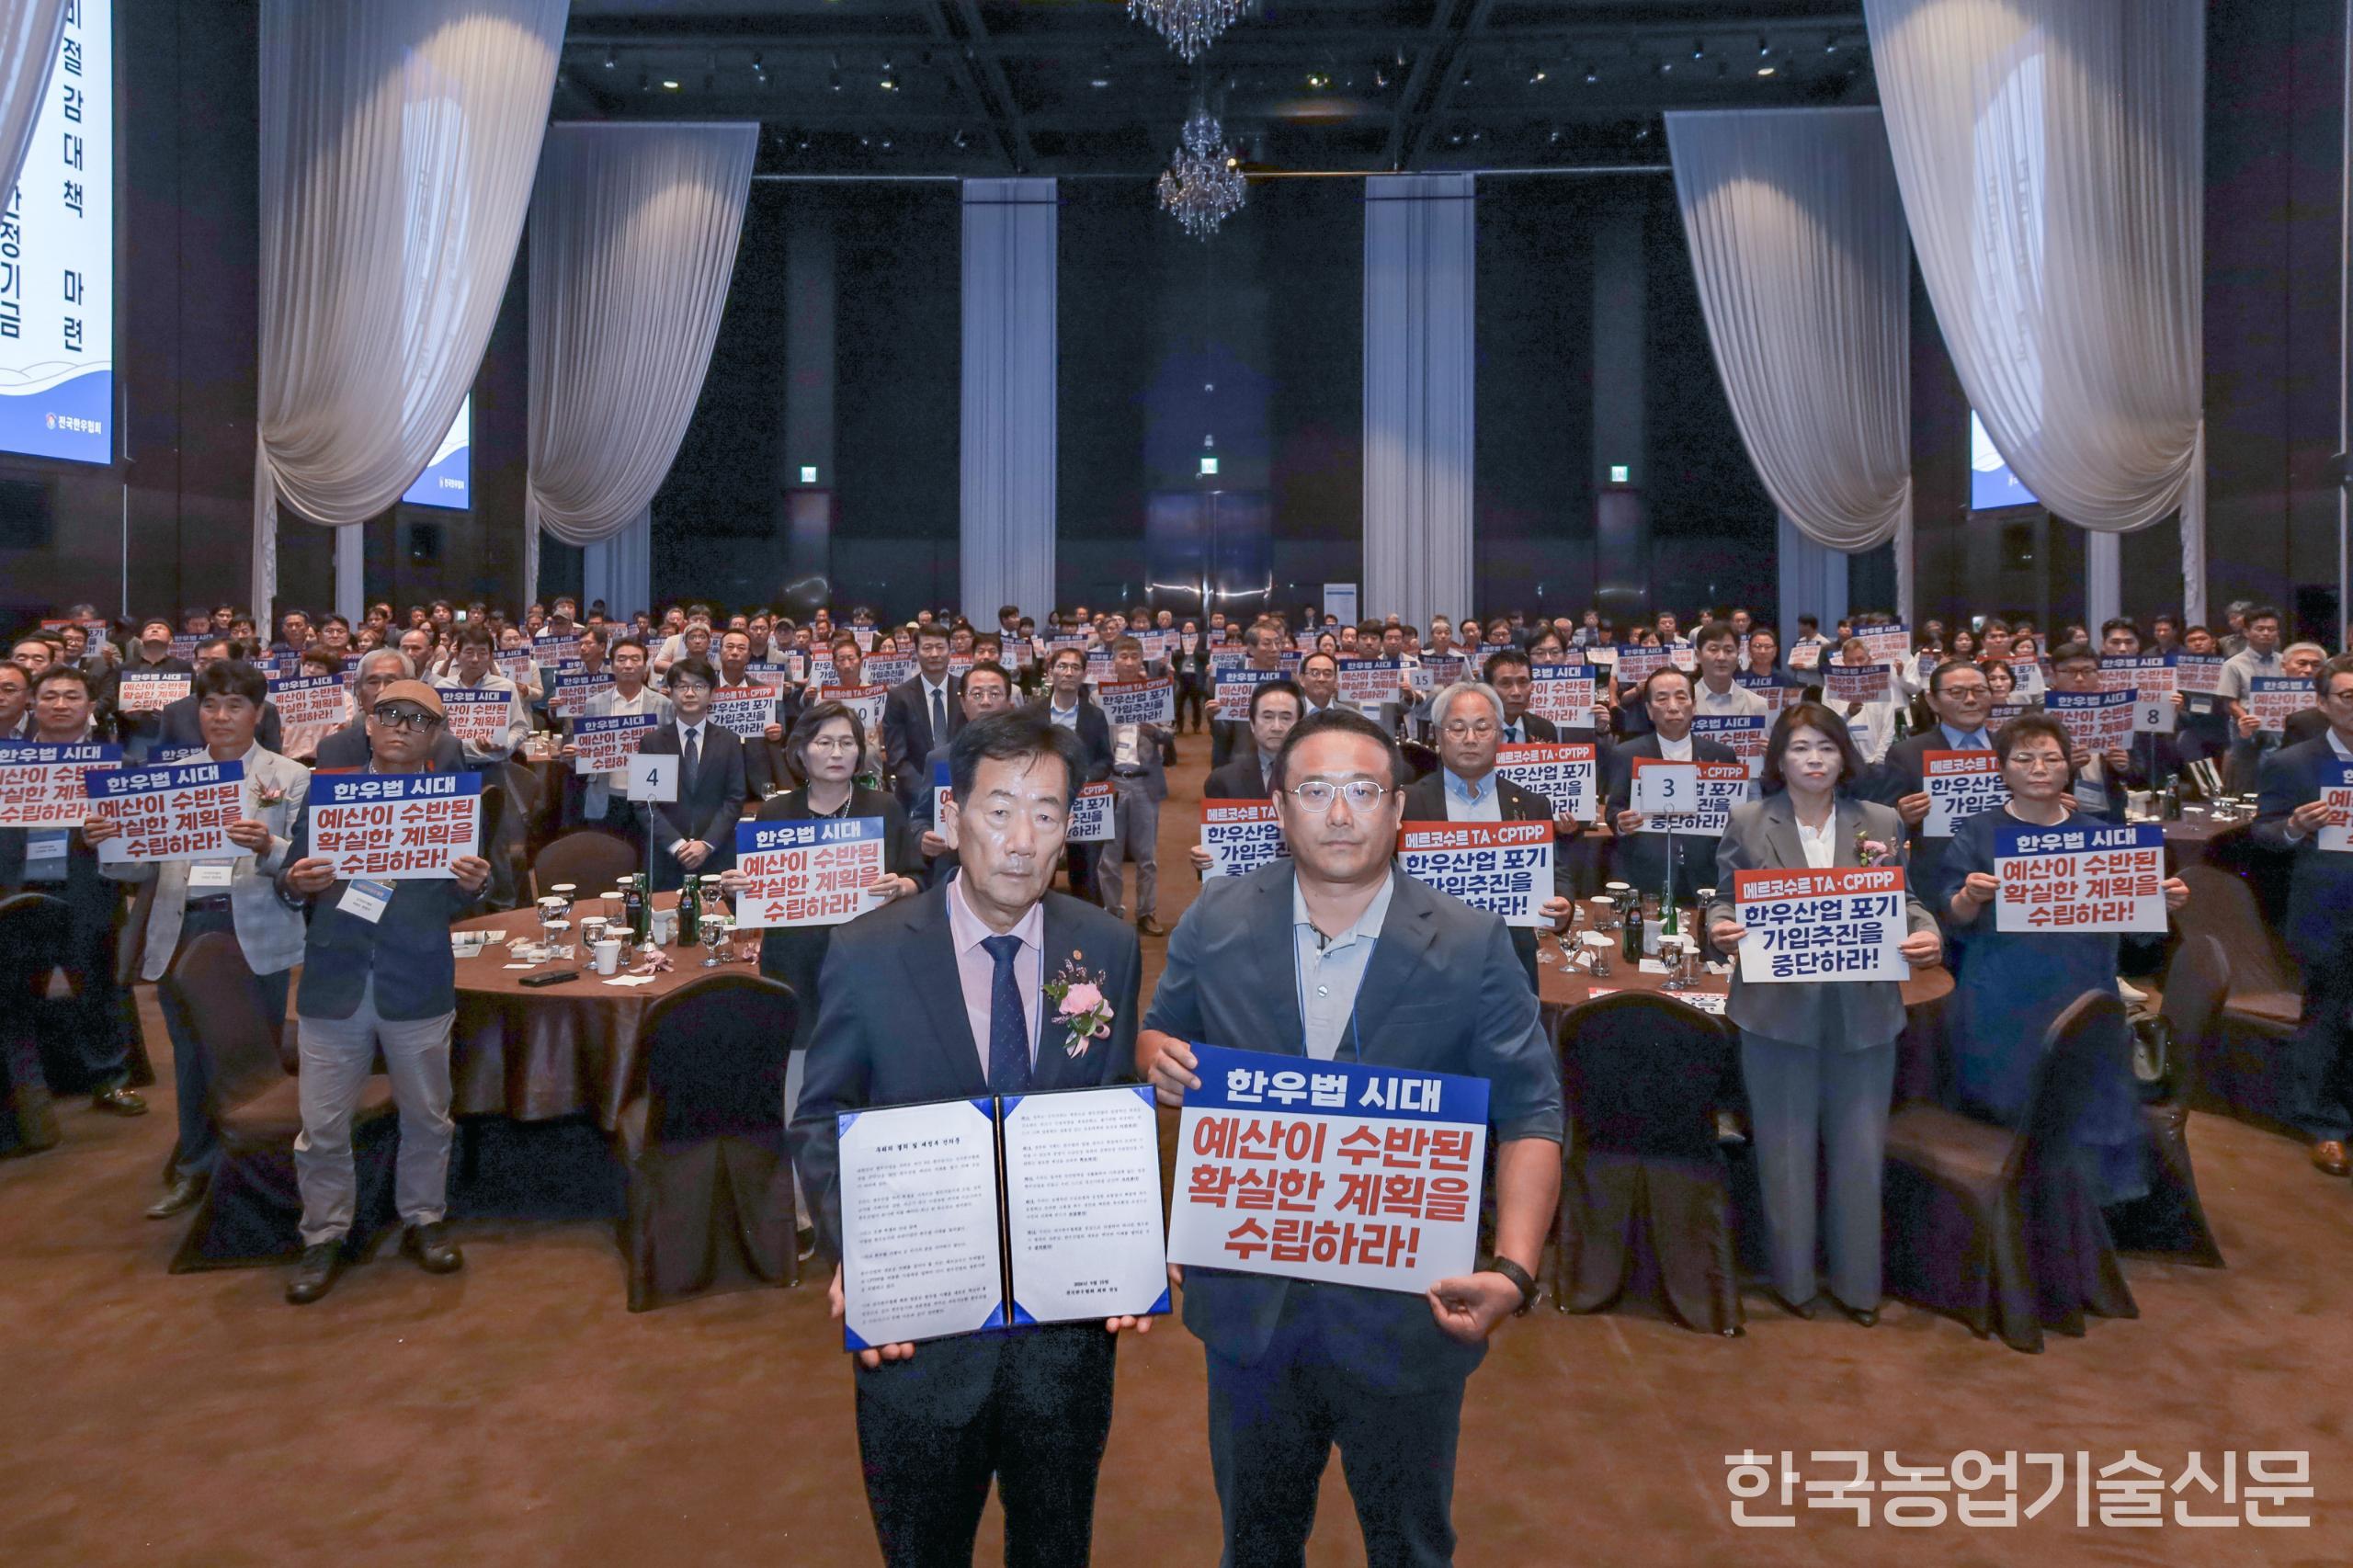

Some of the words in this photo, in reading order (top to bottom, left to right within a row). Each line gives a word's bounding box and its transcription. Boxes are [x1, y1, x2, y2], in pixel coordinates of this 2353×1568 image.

[64, 269, 84, 352] 마련
[1347, 662, 1372, 670] 한우법
[2102, 658, 2137, 668] 한우법
[2140, 657, 2165, 666] 시대
[162, 673, 181, 681] 시대
[1226, 673, 1256, 682] 한우법
[1259, 672, 1279, 680] 시대
[1341, 671, 1369, 680] 예산이
[1556, 667, 1581, 677] 시대
[2135, 669, 2175, 679] 수반된
[278, 680, 309, 690] 한우법
[313, 676, 332, 686] 시대
[563, 676, 588, 686] 한우법
[1415, 676, 1428, 686] 15
[1552, 681, 1591, 694] 수반된
[1750, 677, 1772, 687] 시대
[2263, 681, 2302, 691] 한우법
[310, 687, 342, 699] 수반된
[443, 692, 475, 701] 한우법
[478, 691, 500, 700] 시대
[1103, 694, 1147, 706] 한우산업
[1150, 688, 1170, 701] 포기
[1219, 685, 1251, 696] 예산이
[1349, 690, 1388, 699] 수립하라!
[311, 697, 342, 709] 계획을
[753, 699, 773, 709] 포기
[1111, 699, 1164, 713] 가입추진을
[1553, 695, 1591, 708] 계획을
[2058, 695, 2100, 707] 한우법
[2104, 692, 2127, 704] 시대
[2255, 693, 2296, 704] 예산이
[472, 704, 507, 714] 수반된
[714, 710, 766, 723] 가입추진을
[2098, 704, 2133, 720] 수반된
[286, 711, 333, 723] 수립하라!
[472, 716, 506, 726] 계획을
[585, 719, 619, 731] 한우법
[622, 717, 645, 726] 시대
[1114, 710, 1163, 724] 중단하라!
[1725, 718, 1750, 728] 시대
[2147, 710, 2159, 724] 8
[579, 733, 615, 745] 예산이
[0, 747, 57, 762] 한우법
[63, 746, 101, 759] 시대
[1495, 749, 1540, 763] 메르코수르
[1562, 763, 1591, 778] 포기
[1930, 757, 1986, 774] 메르코수르
[0, 767, 48, 785] 산이
[107, 772, 170, 792] 한우법
[177, 765, 220, 784] 시대
[646, 768, 658, 786] 4
[0, 787, 47, 803] 실한
[334, 779, 404, 801] 한우법
[411, 777, 456, 795] 시대
[1663, 778, 1675, 797] 3
[1709, 783, 1743, 796] 포기
[97, 795, 165, 818] 예산이
[172, 784, 240, 810] 수반된
[1086, 796, 1109, 810] 포기
[0, 803, 90, 823] 수립하라!
[176, 806, 243, 831] 계획을
[317, 805, 393, 829] 예산이
[401, 799, 474, 824] 수반된
[1207, 807, 1258, 821] 메르코수르
[1651, 814, 1725, 829] 중단하라!
[317, 828, 394, 852] 확실한
[401, 822, 473, 846] 계획을
[756, 826, 815, 848] 한우법
[822, 821, 860, 840] 시대
[1208, 824, 1280, 844] 한우산업
[1404, 830, 1469, 848] 메르코수르
[1472, 824, 1545, 845] TA·CPTPP
[2017, 832, 2085, 853] 한우법
[2091, 828, 2137, 846] 시대
[127, 831, 222, 858] 수립하라!
[340, 848, 448, 874] 수립하라!
[744, 851, 807, 876] 예산이
[813, 843, 879, 868] 수반된
[1406, 851, 1496, 874] 한우산업
[1503, 847, 1547, 869] 포기
[2003, 858, 2076, 881] 예산이
[2083, 851, 2157, 875] 수반된
[815, 866, 880, 891] 계획을
[1744, 877, 1812, 899] 메르코수르
[1814, 871, 1894, 892] TA·CPTPP
[2004, 881, 2079, 904] 확실한
[2085, 874, 2158, 899] 계획을
[765, 892, 858, 921] 수립하라!
[1745, 900, 1842, 927] 한우산업
[1849, 895, 1897, 919] 포기
[2028, 901, 2134, 926] 수립하라!
[1763, 922, 1883, 950] 가입추진을
[1772, 949, 1878, 977] 중단하라!
[1227, 1068, 1347, 1108] 한우법
[1358, 1077, 1441, 1113] 시대
[1192, 1117, 1327, 1163] 예산이
[1336, 1125, 1473, 1172] 수반된
[1188, 1165, 1324, 1212] 확실한
[1335, 1171, 1469, 1221] 계획을
[1225, 1218, 1420, 1267] 수립하라!
